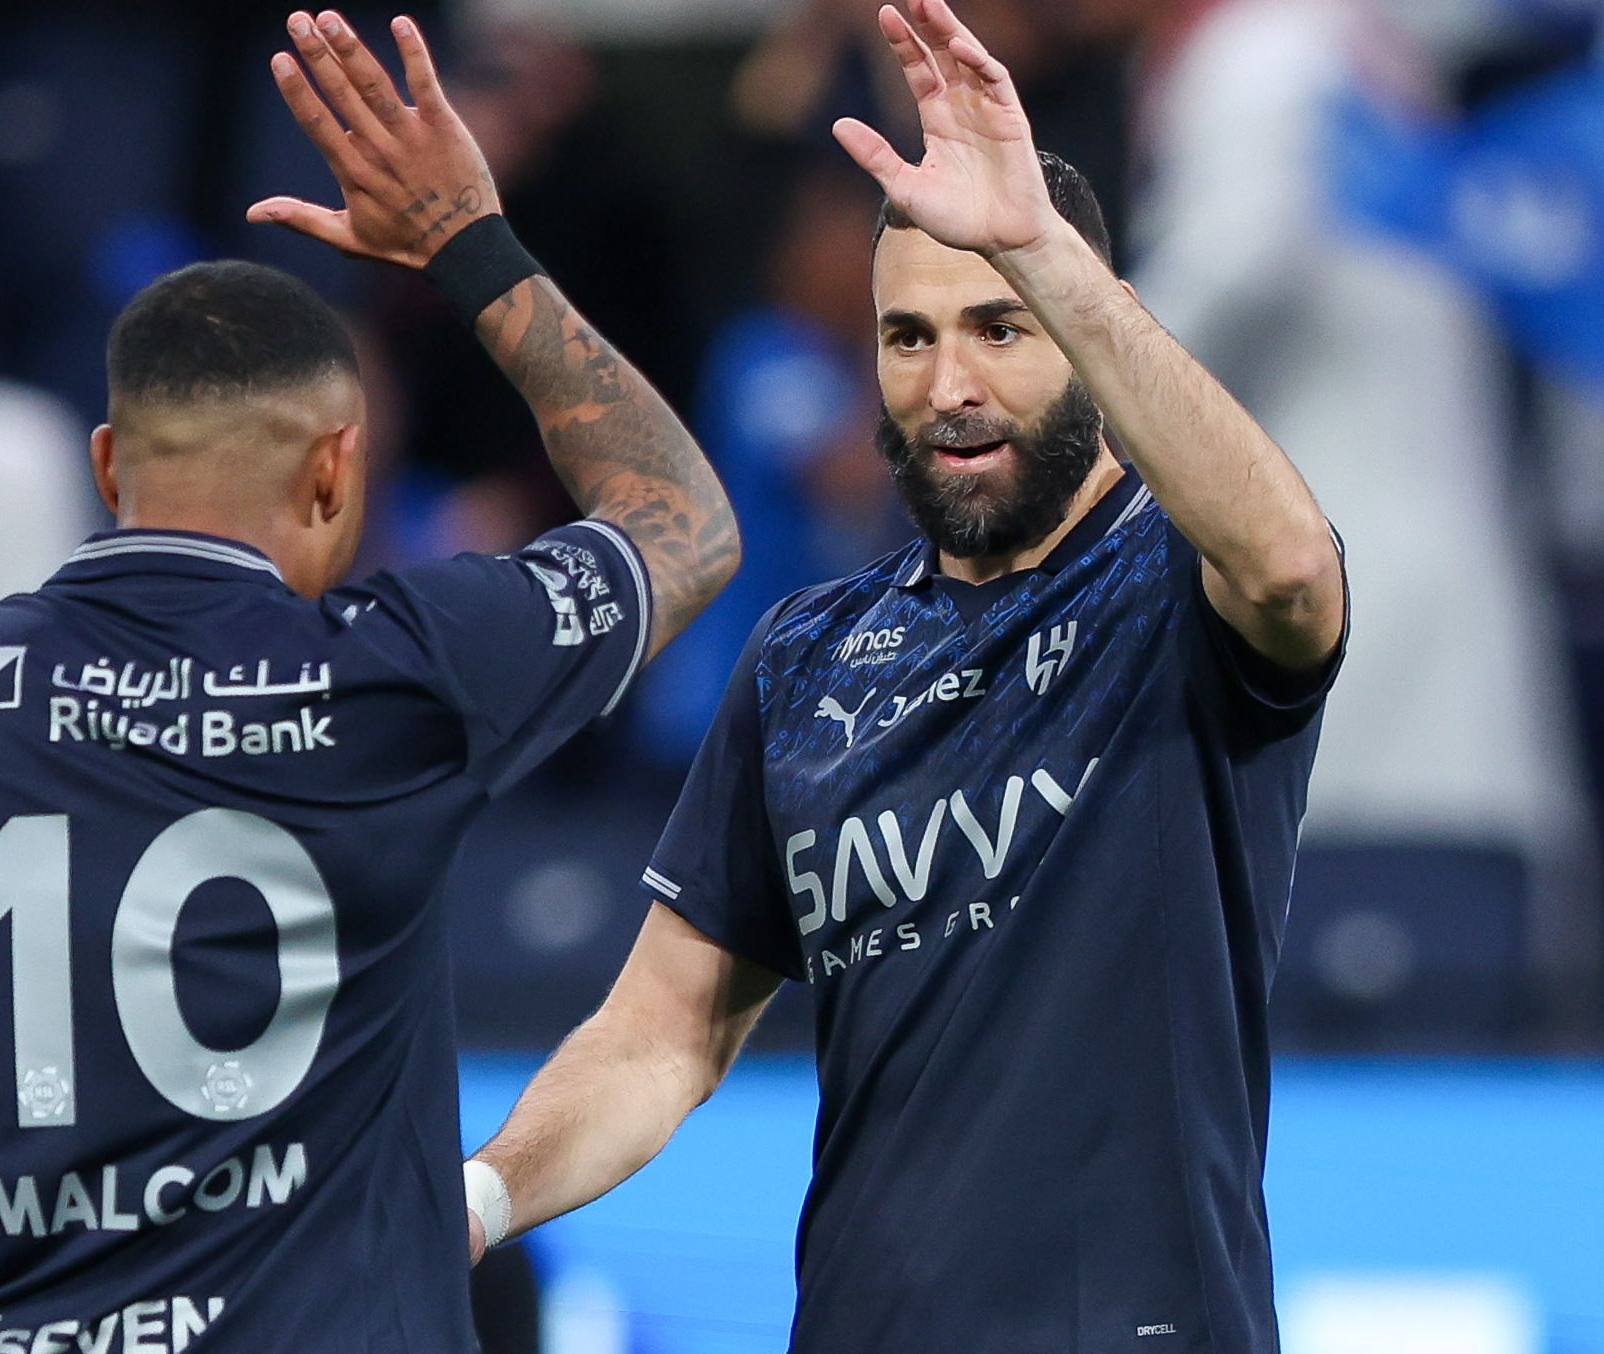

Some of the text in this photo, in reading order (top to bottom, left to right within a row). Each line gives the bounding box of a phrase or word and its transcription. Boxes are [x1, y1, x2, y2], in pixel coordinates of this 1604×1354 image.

[51, 657, 332, 708] بنك الرياض
[877, 668, 987, 727] jez
[49, 696, 336, 757] Riyad Bank
[1136, 1323, 1177, 1337] DRYCELL
